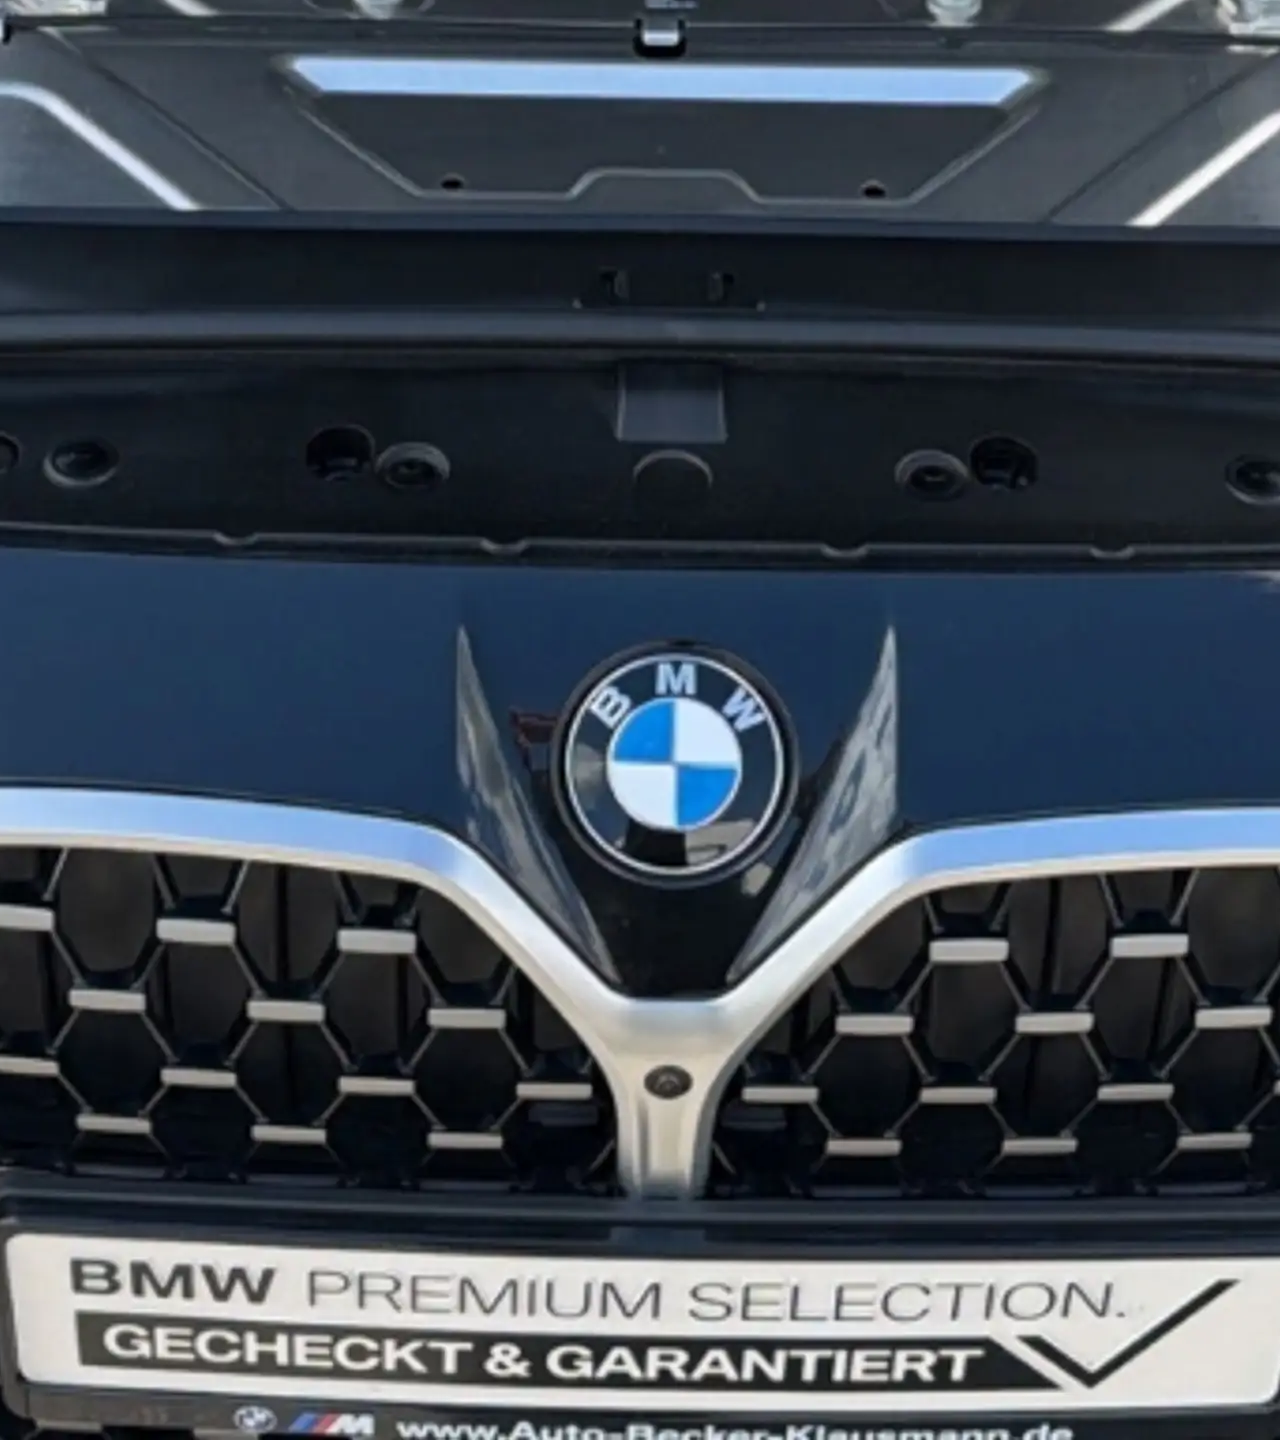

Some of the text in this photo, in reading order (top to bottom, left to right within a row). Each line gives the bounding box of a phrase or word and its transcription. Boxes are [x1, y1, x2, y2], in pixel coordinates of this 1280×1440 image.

[591, 662, 766, 732] BMW
[70, 1258, 1127, 1323] BMW PREMIUM SELECTION.
[103, 1323, 984, 1384] GECHECKT & GARANTIERT
